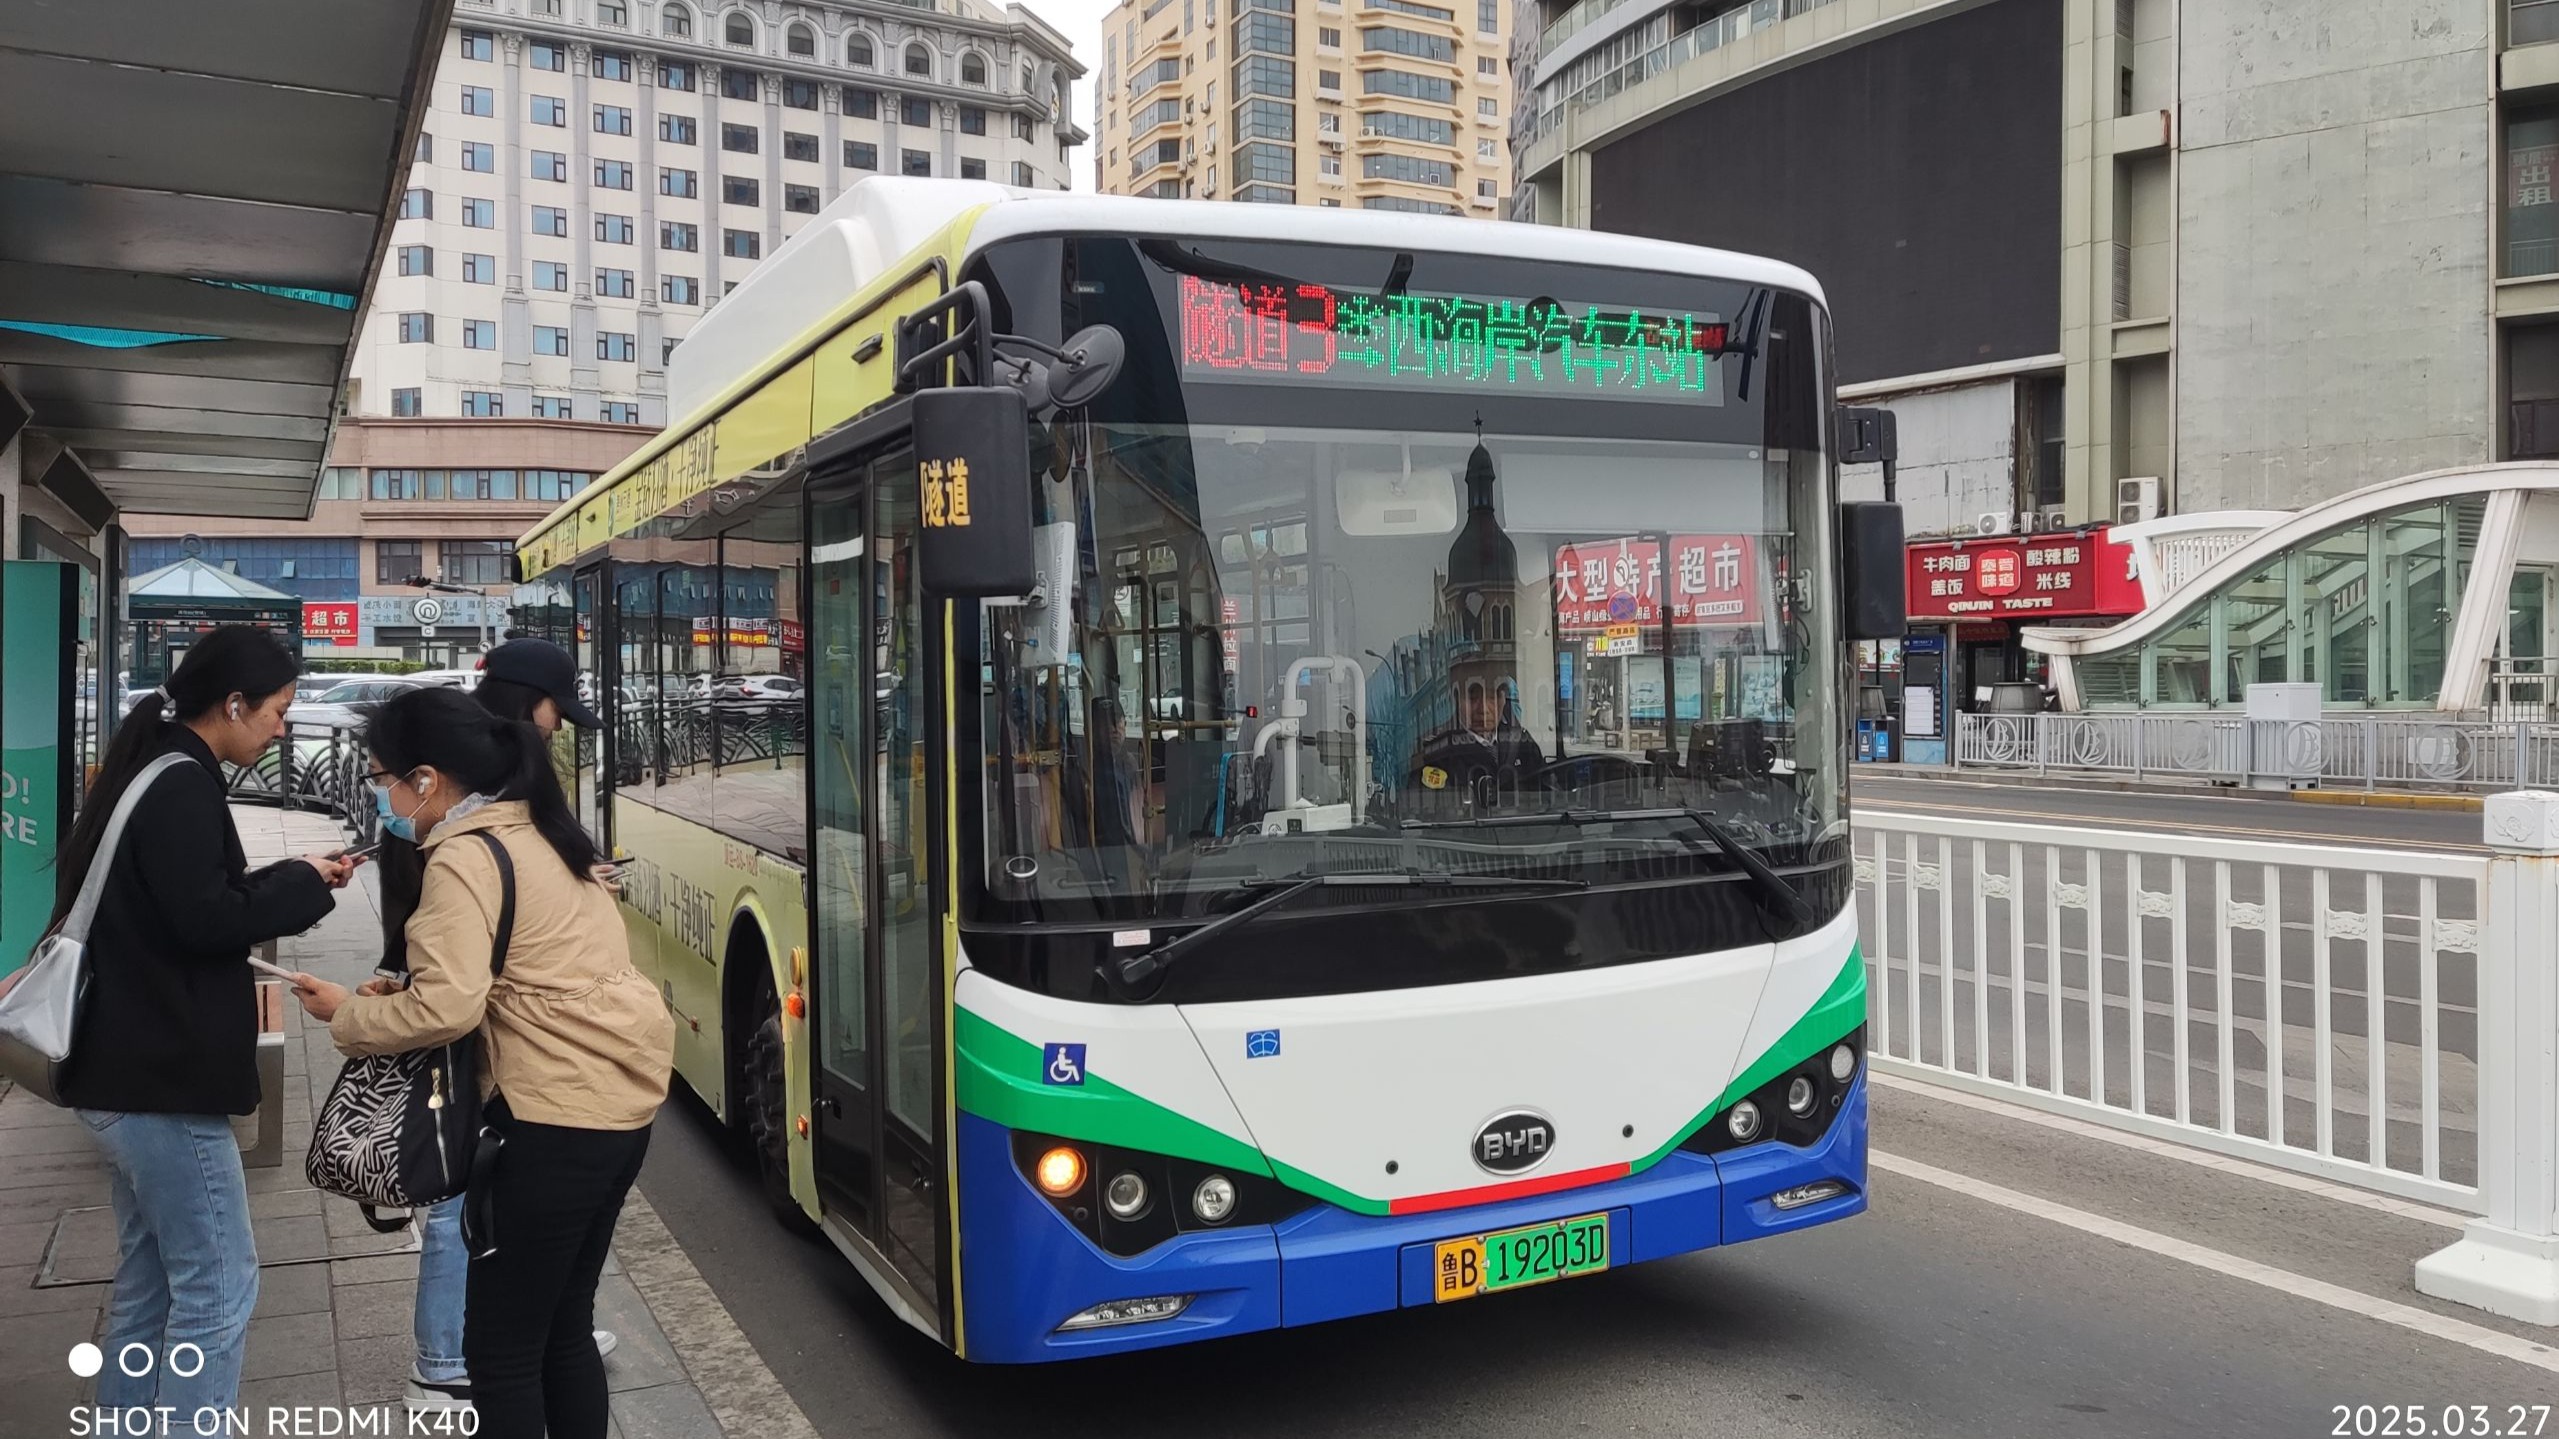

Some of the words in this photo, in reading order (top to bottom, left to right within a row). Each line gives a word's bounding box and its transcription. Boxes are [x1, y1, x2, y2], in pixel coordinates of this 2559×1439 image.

[2518, 165, 2552, 206] 出租
[1183, 275, 1335, 373] 隧道3
[1387, 294, 1704, 392] 西海岸汽车东站
[920, 457, 971, 528] 隧道
[1923, 555, 1970, 573] 牛肉面
[2026, 547, 2080, 567] 酸辣粉
[1556, 541, 1741, 603] 大型特产超市
[1981, 574, 2015, 588] 味道
[2036, 572, 2072, 591] 米线
[1931, 579, 1963, 596] 盖饭
[1657, 604, 1690, 618] 行寄存
[1948, 600, 1994, 612] QINJIN
[2002, 597, 2053, 609] TASTE
[424, 627, 433, 635] C
[1223, 600, 1237, 672] 兰州拉面
[1483, 1126, 1547, 1160] BYD
[1442, 1248, 1478, 1291] 鲁B
[1498, 1224, 1604, 1283] 19203D
